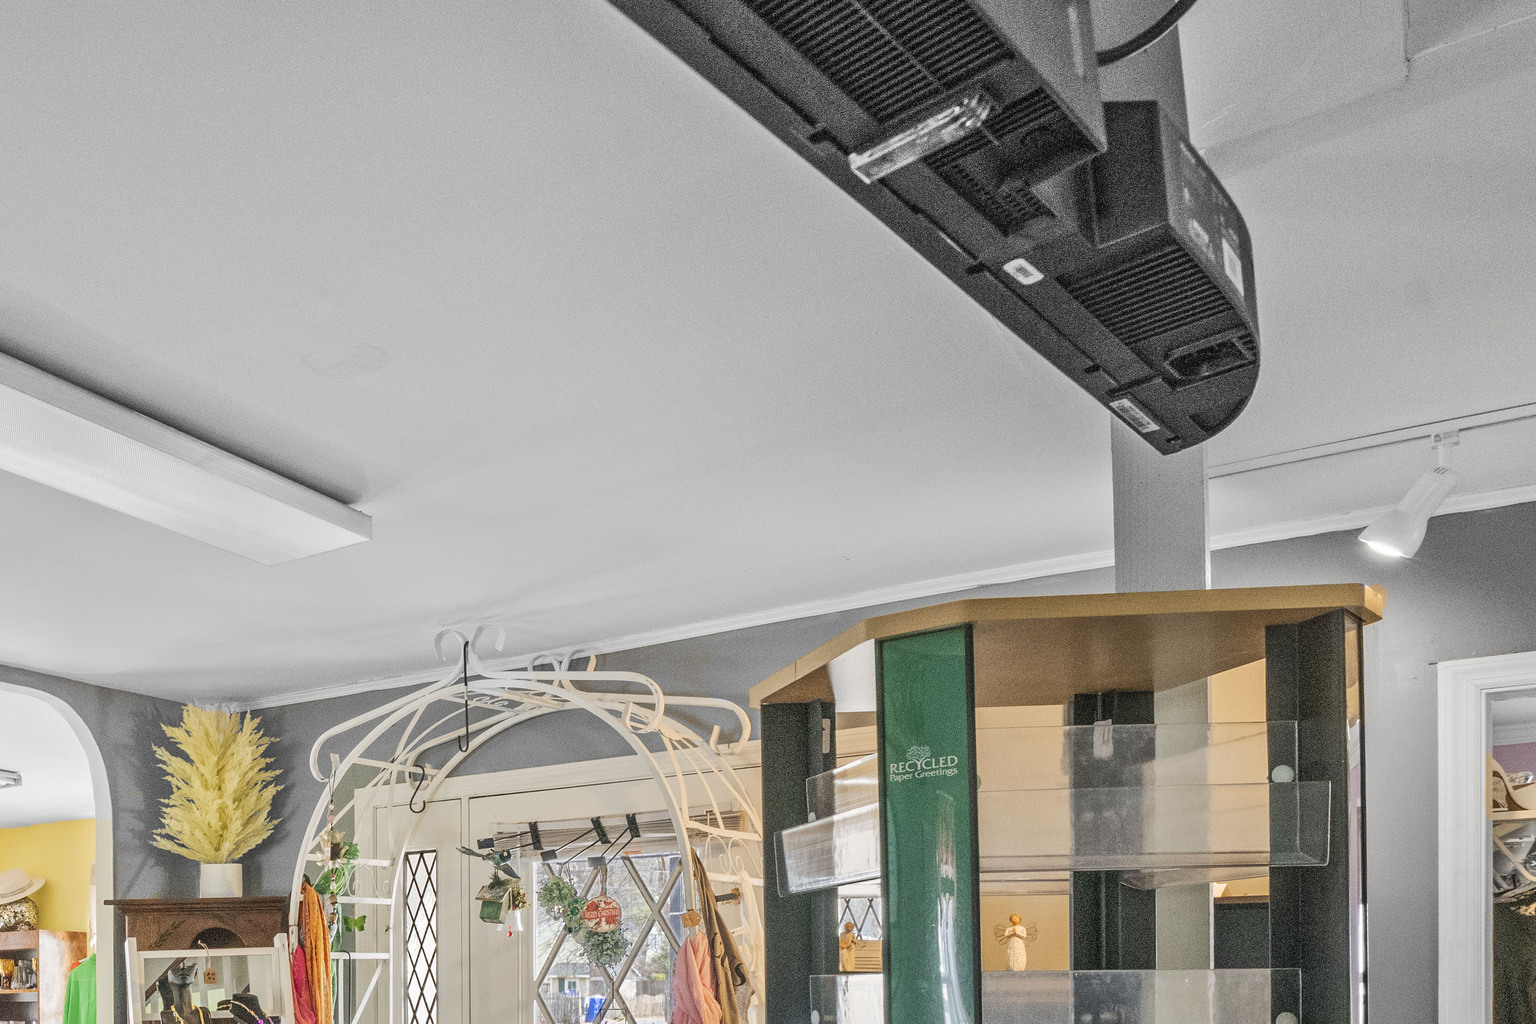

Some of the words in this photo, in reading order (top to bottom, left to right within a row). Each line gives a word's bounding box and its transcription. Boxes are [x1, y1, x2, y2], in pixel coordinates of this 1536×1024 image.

[890, 756, 958, 773] RECYCLED
[890, 774, 913, 782] Paper
[915, 768, 958, 779] Greetings
